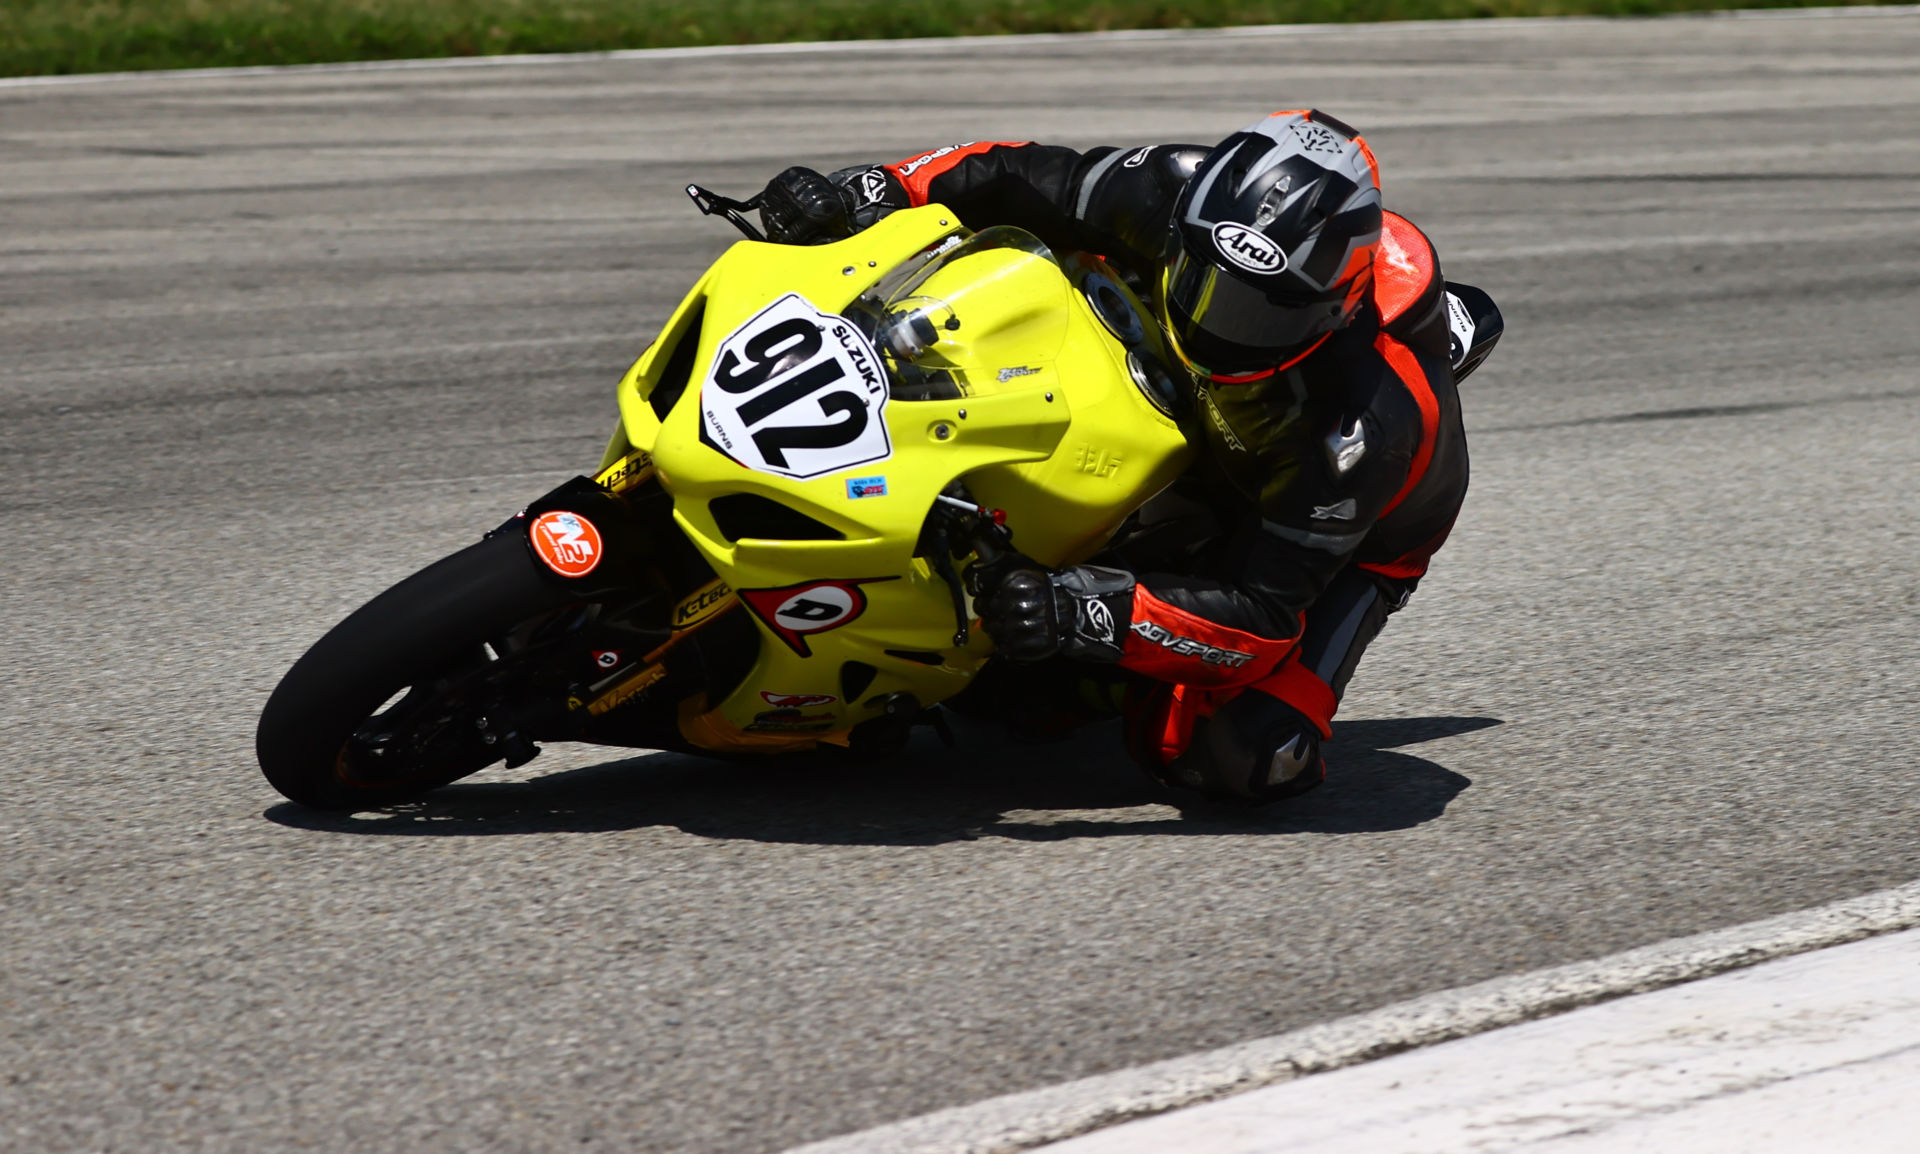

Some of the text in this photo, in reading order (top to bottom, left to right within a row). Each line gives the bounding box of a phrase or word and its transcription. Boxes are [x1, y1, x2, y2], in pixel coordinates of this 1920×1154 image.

[1217, 231, 1278, 266] Arai
[832, 324, 882, 394] SUZUKI
[713, 318, 869, 469] 912
[706, 410, 733, 450] BURNS
